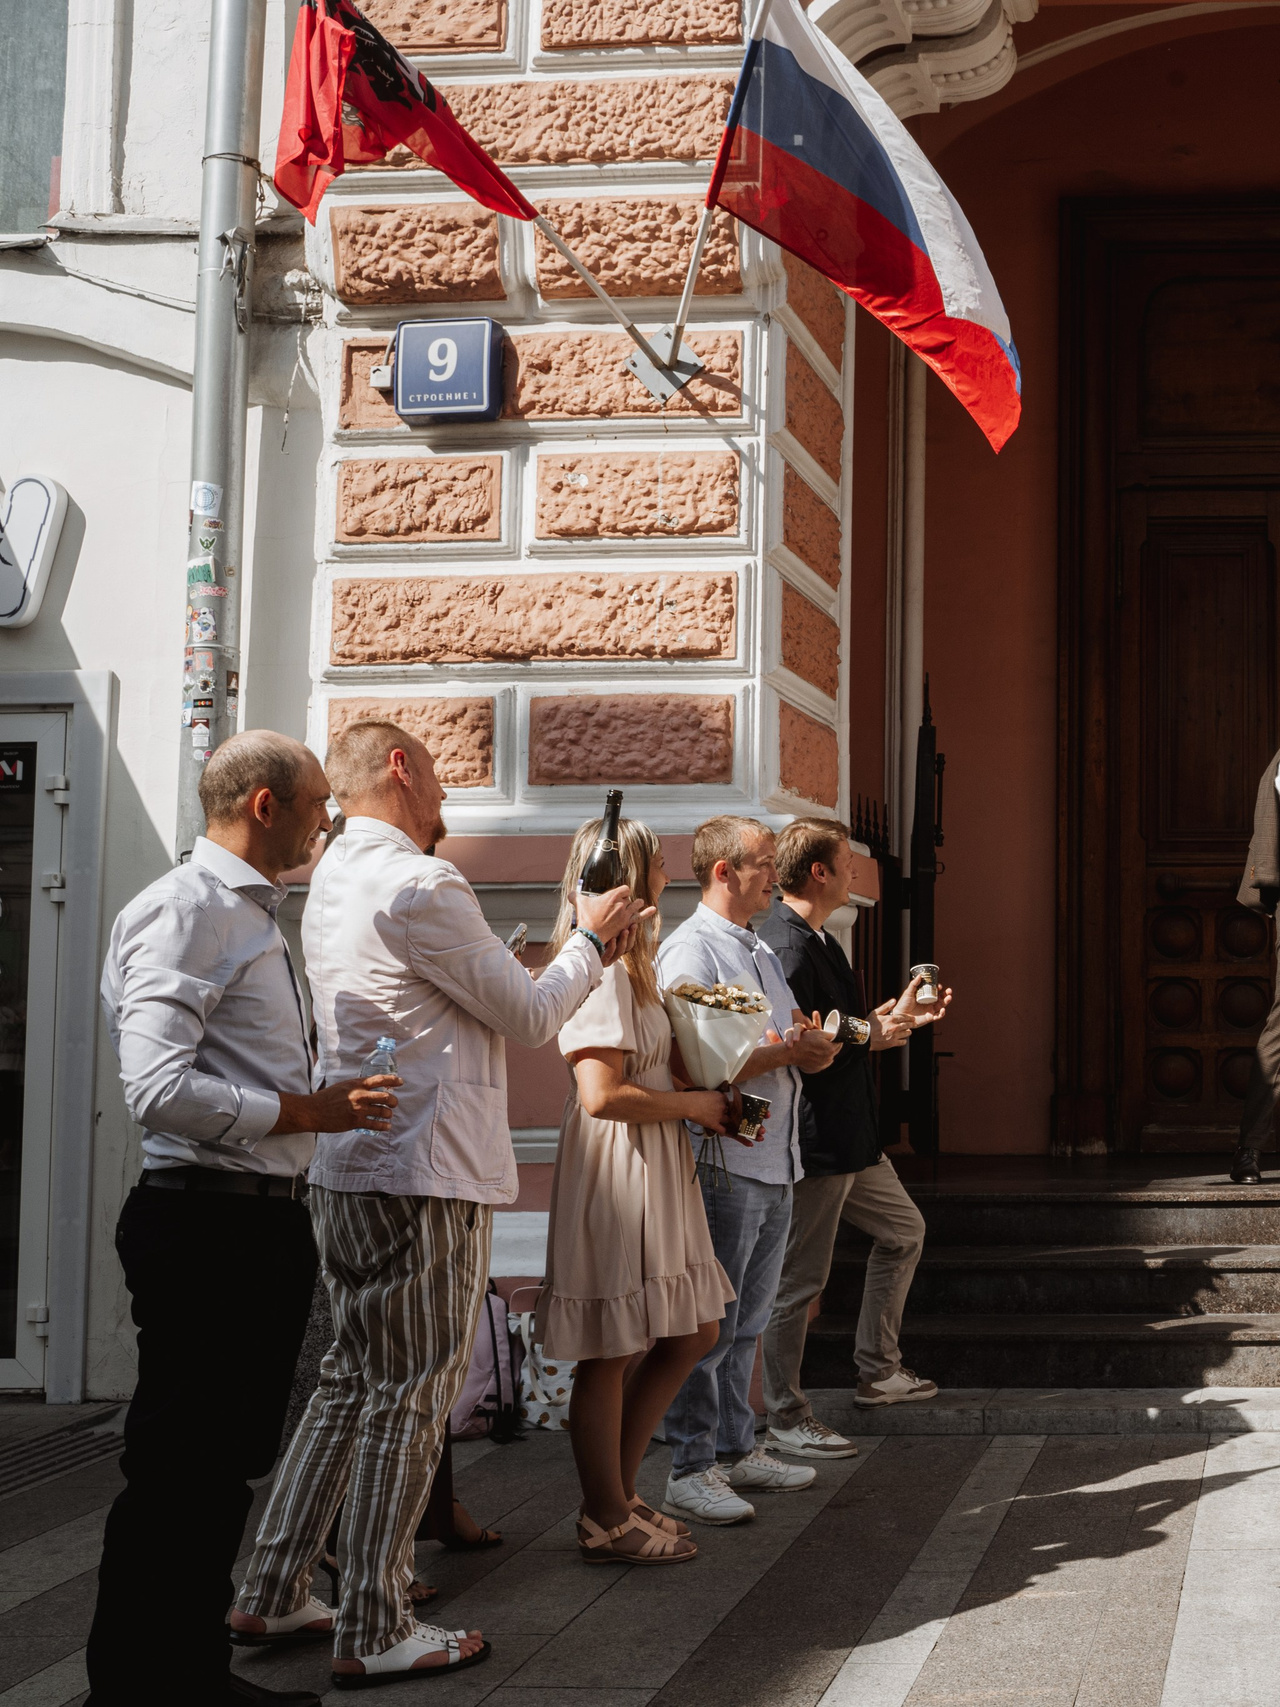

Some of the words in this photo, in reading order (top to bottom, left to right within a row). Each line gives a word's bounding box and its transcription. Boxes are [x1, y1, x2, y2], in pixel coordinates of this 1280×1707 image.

[428, 337, 458, 381] 9
[408, 392, 469, 402] СТРОЕНИЕ
[472, 391, 477, 399] 1
